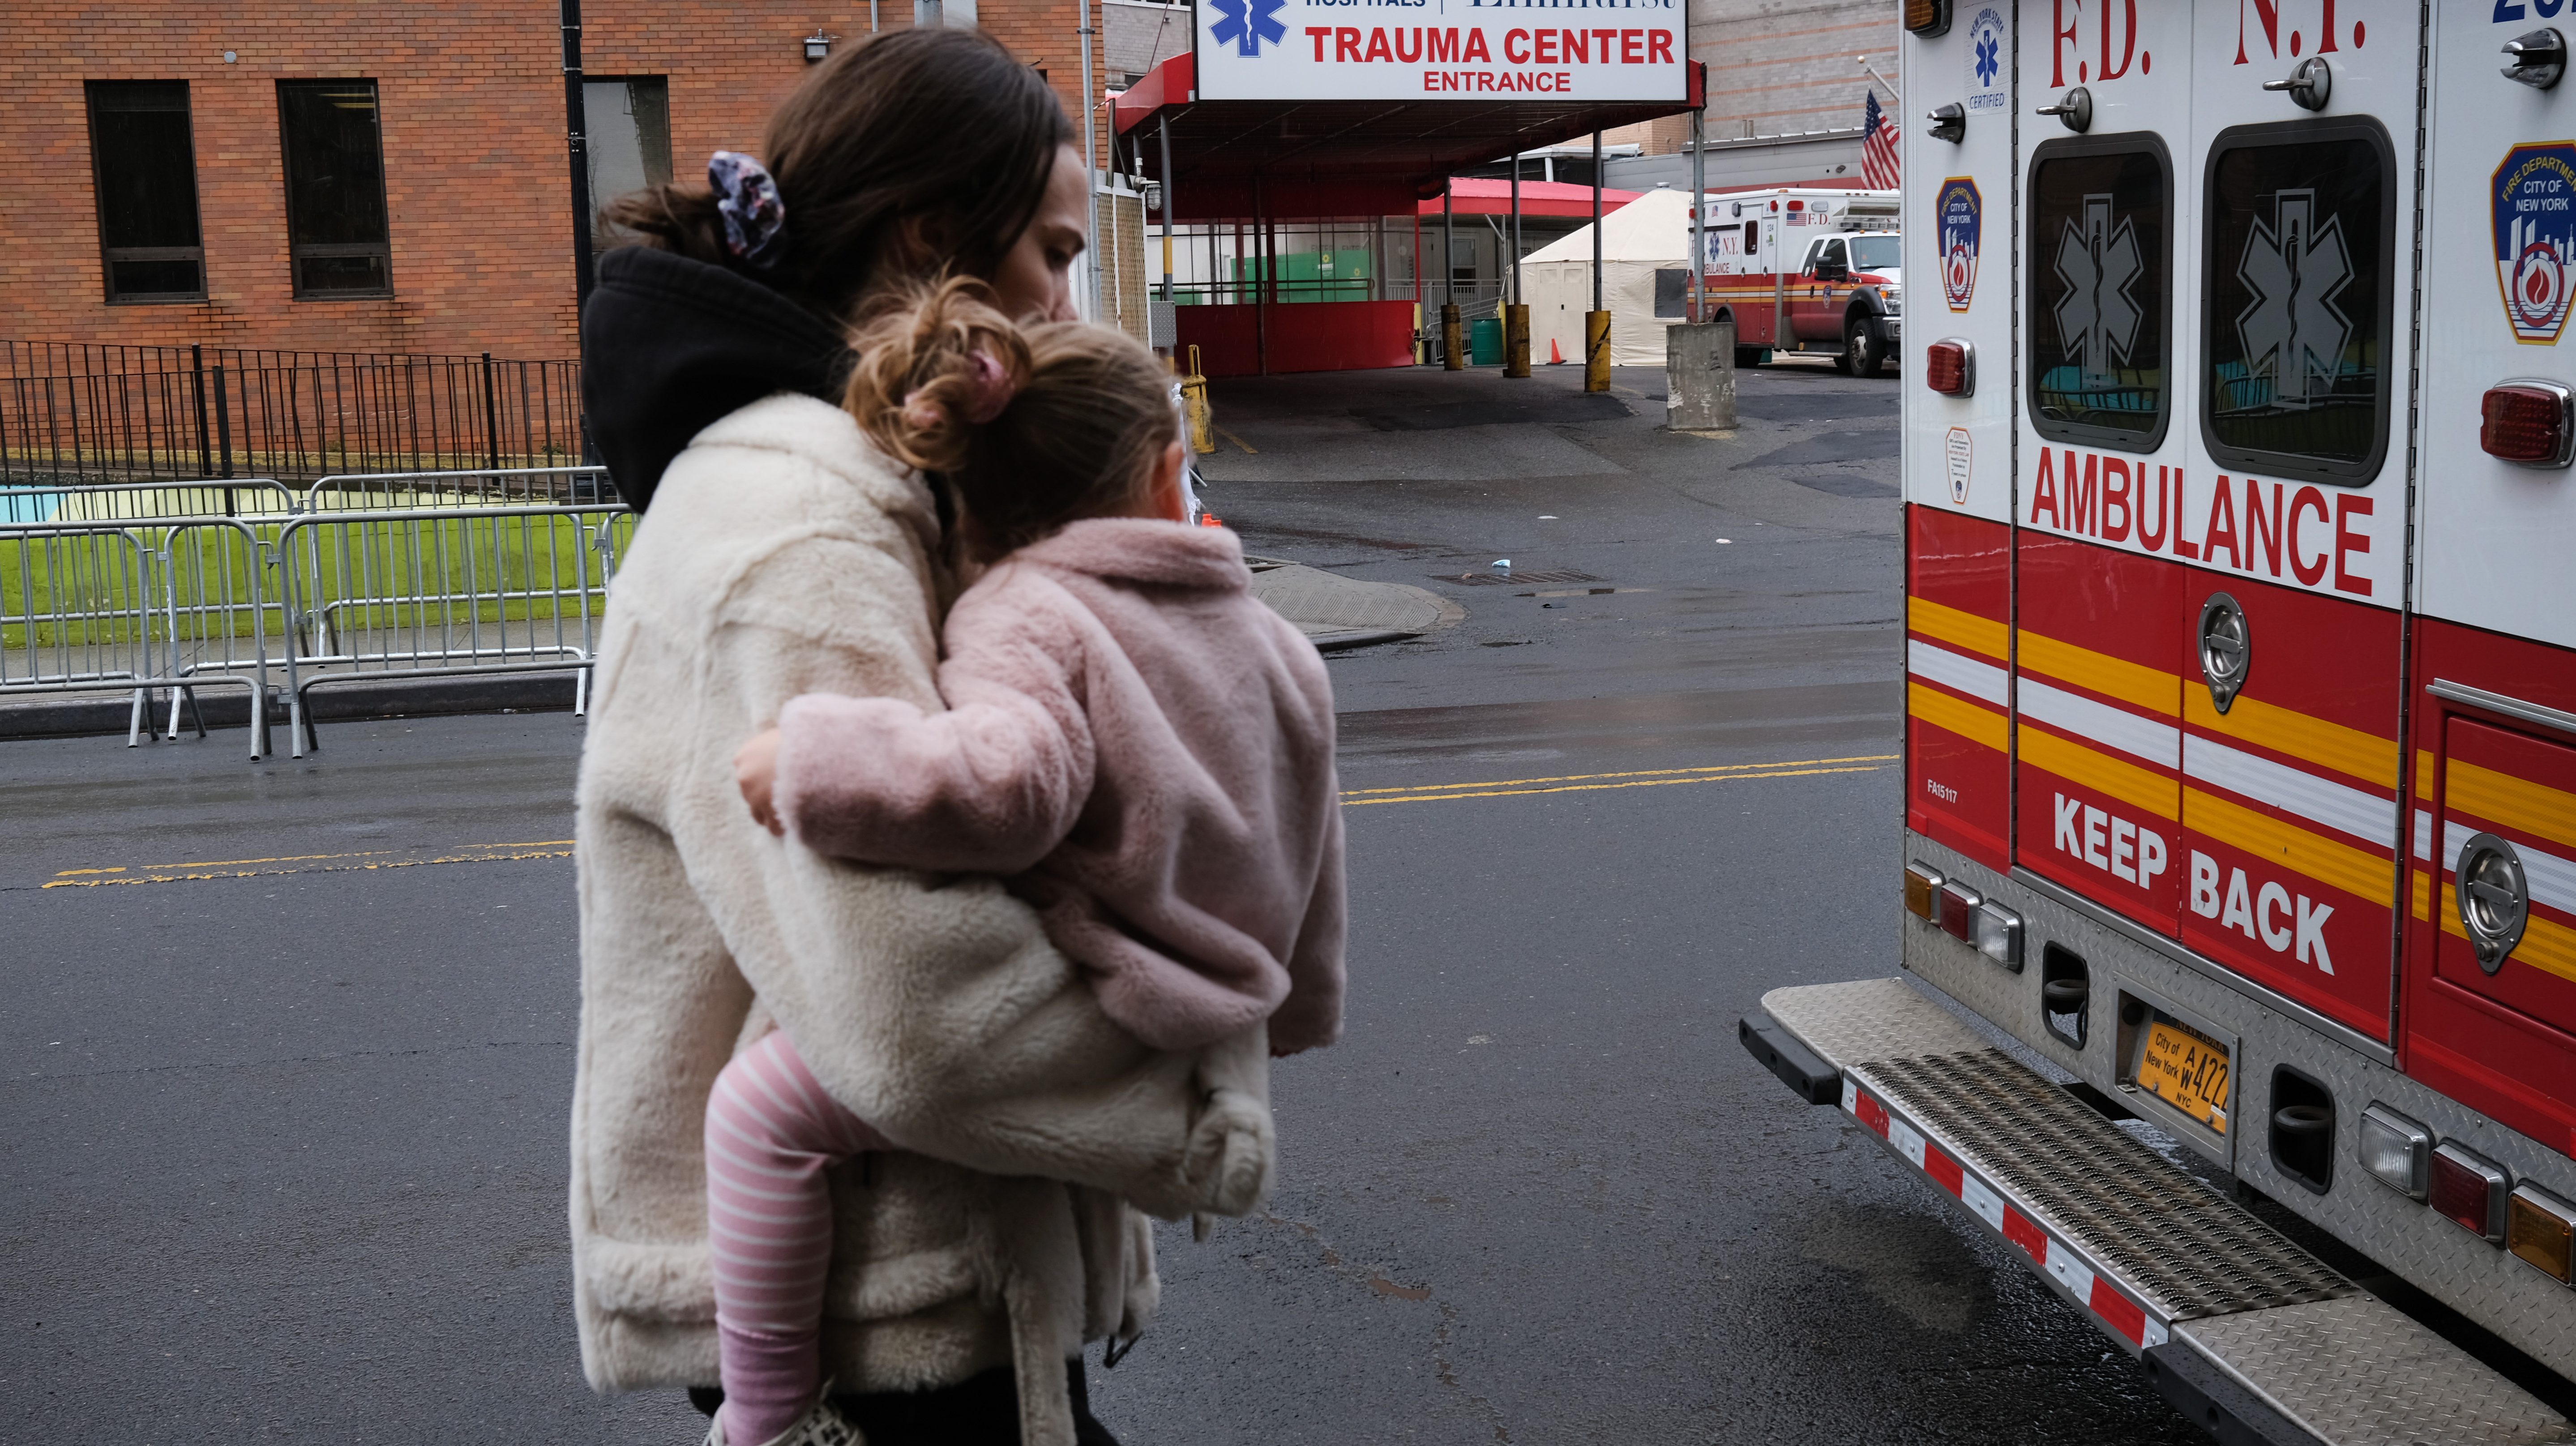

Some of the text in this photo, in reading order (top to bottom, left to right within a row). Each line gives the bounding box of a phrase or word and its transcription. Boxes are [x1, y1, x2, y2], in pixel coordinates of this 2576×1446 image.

[1970, 17, 1979, 39] NEW
[1979, 8, 1991, 21] YORK
[1991, 10, 2004, 34] STATE
[1305, 27, 1674, 64] TRAUMA CENTER
[1424, 72, 1571, 92] ENTRANCE
[1970, 93, 2004, 109] CERTIFIED
[2502, 156, 2576, 201] FIRE DEPARTMEN
[2524, 180, 2563, 193] CITY OF
[1941, 187, 1977, 217] FIRE DEPARTMENT
[1951, 203, 1967, 212] CITY OF
[2516, 198, 2568, 211] NEW YORK
[1808, 214, 1830, 225] F.D.
[1947, 215, 1971, 224] NEW YORK
[1723, 237, 1738, 256] N.Y.
[1704, 263, 1729, 274] BULANCE
[2030, 446, 2374, 597] AMBULANCE
[1928, 779, 1957, 804] FA15117
[2055, 792, 2335, 976] KEEP BACK
[2156, 1033, 2181, 1056] City of
[2145, 1050, 2179, 1079] New York
[2176, 1092, 2191, 1108] NYC
